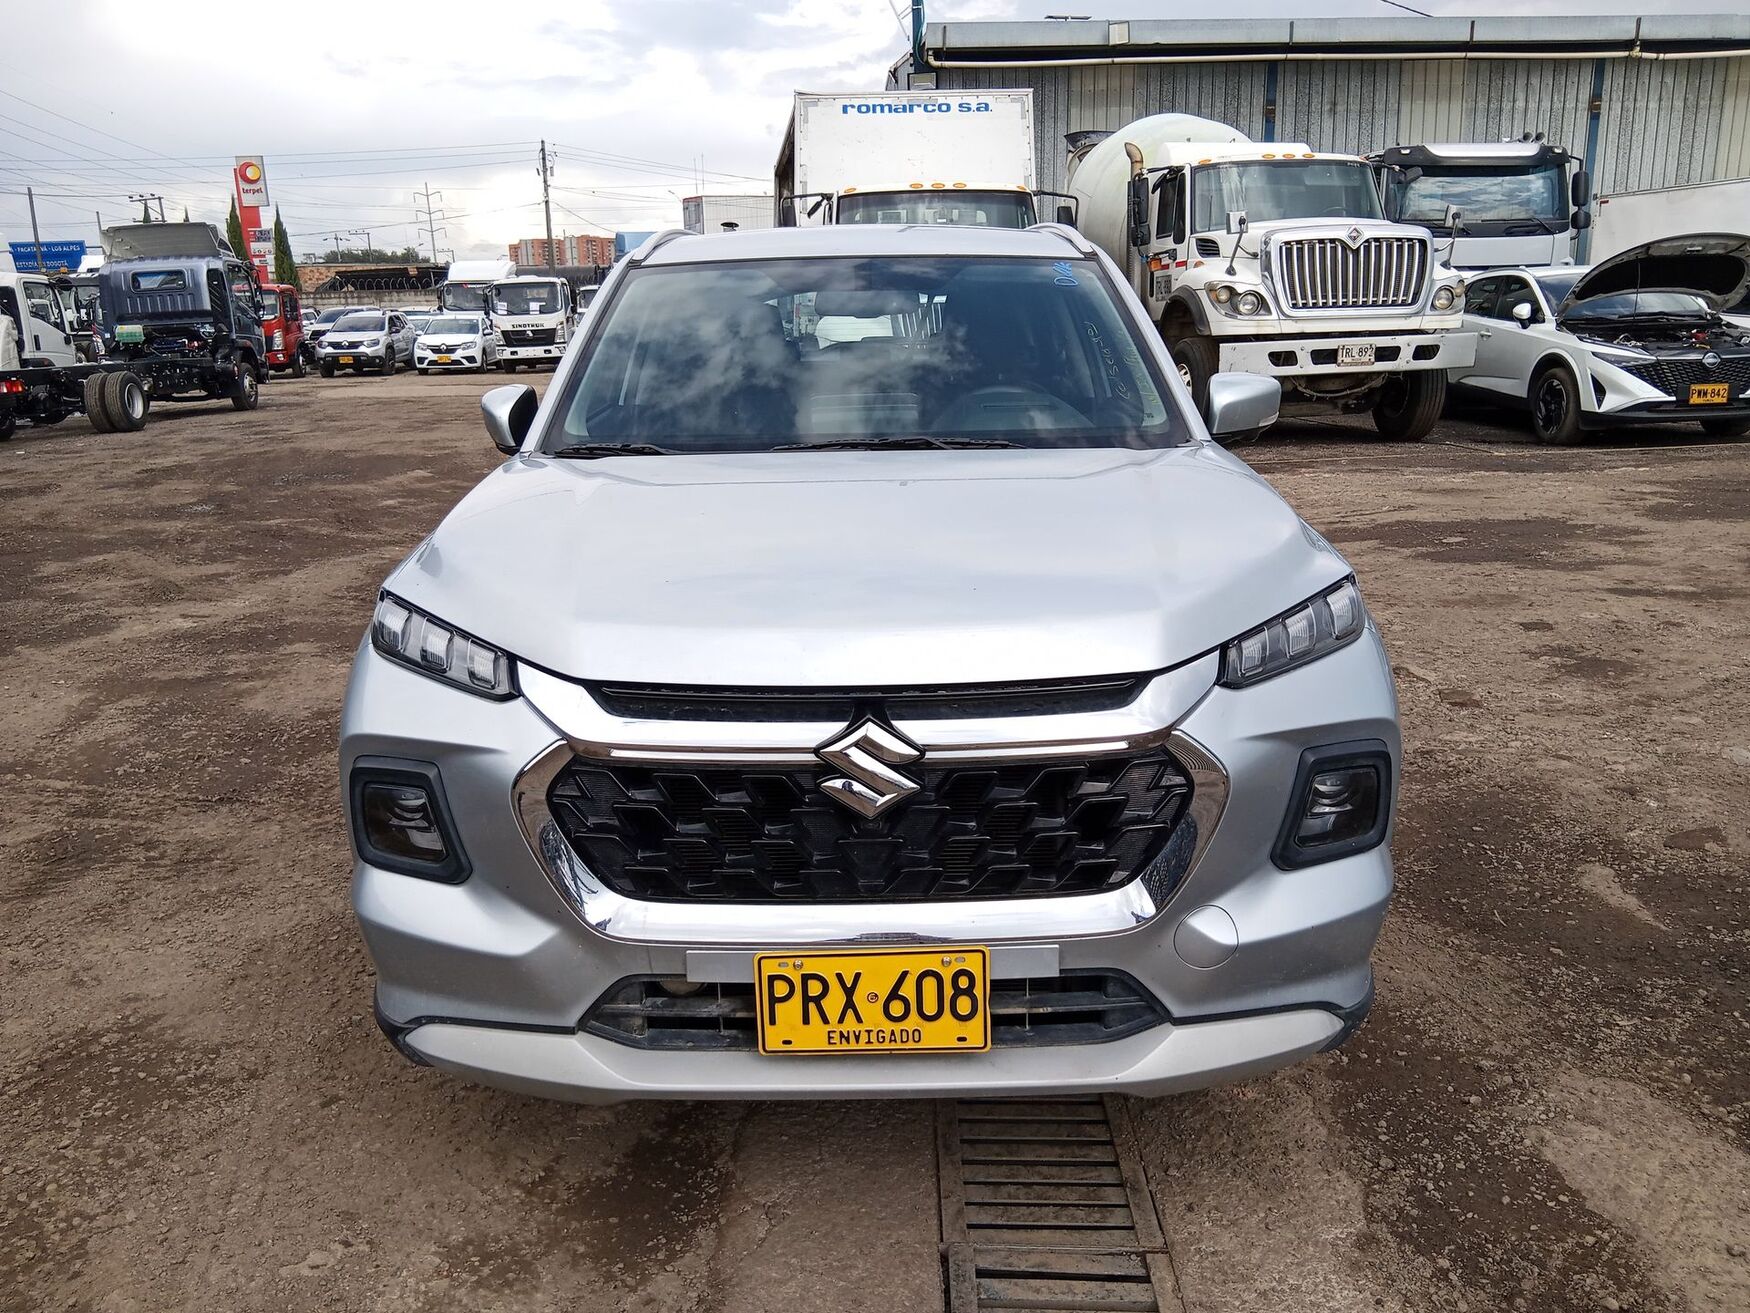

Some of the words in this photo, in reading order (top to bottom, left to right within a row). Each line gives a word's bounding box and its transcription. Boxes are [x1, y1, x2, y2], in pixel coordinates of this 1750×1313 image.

[842, 102, 951, 114] romarco
[958, 102, 993, 113] s.a.
[242, 187, 264, 195] terpel
[827, 1028, 922, 1045] ENVIGADO
